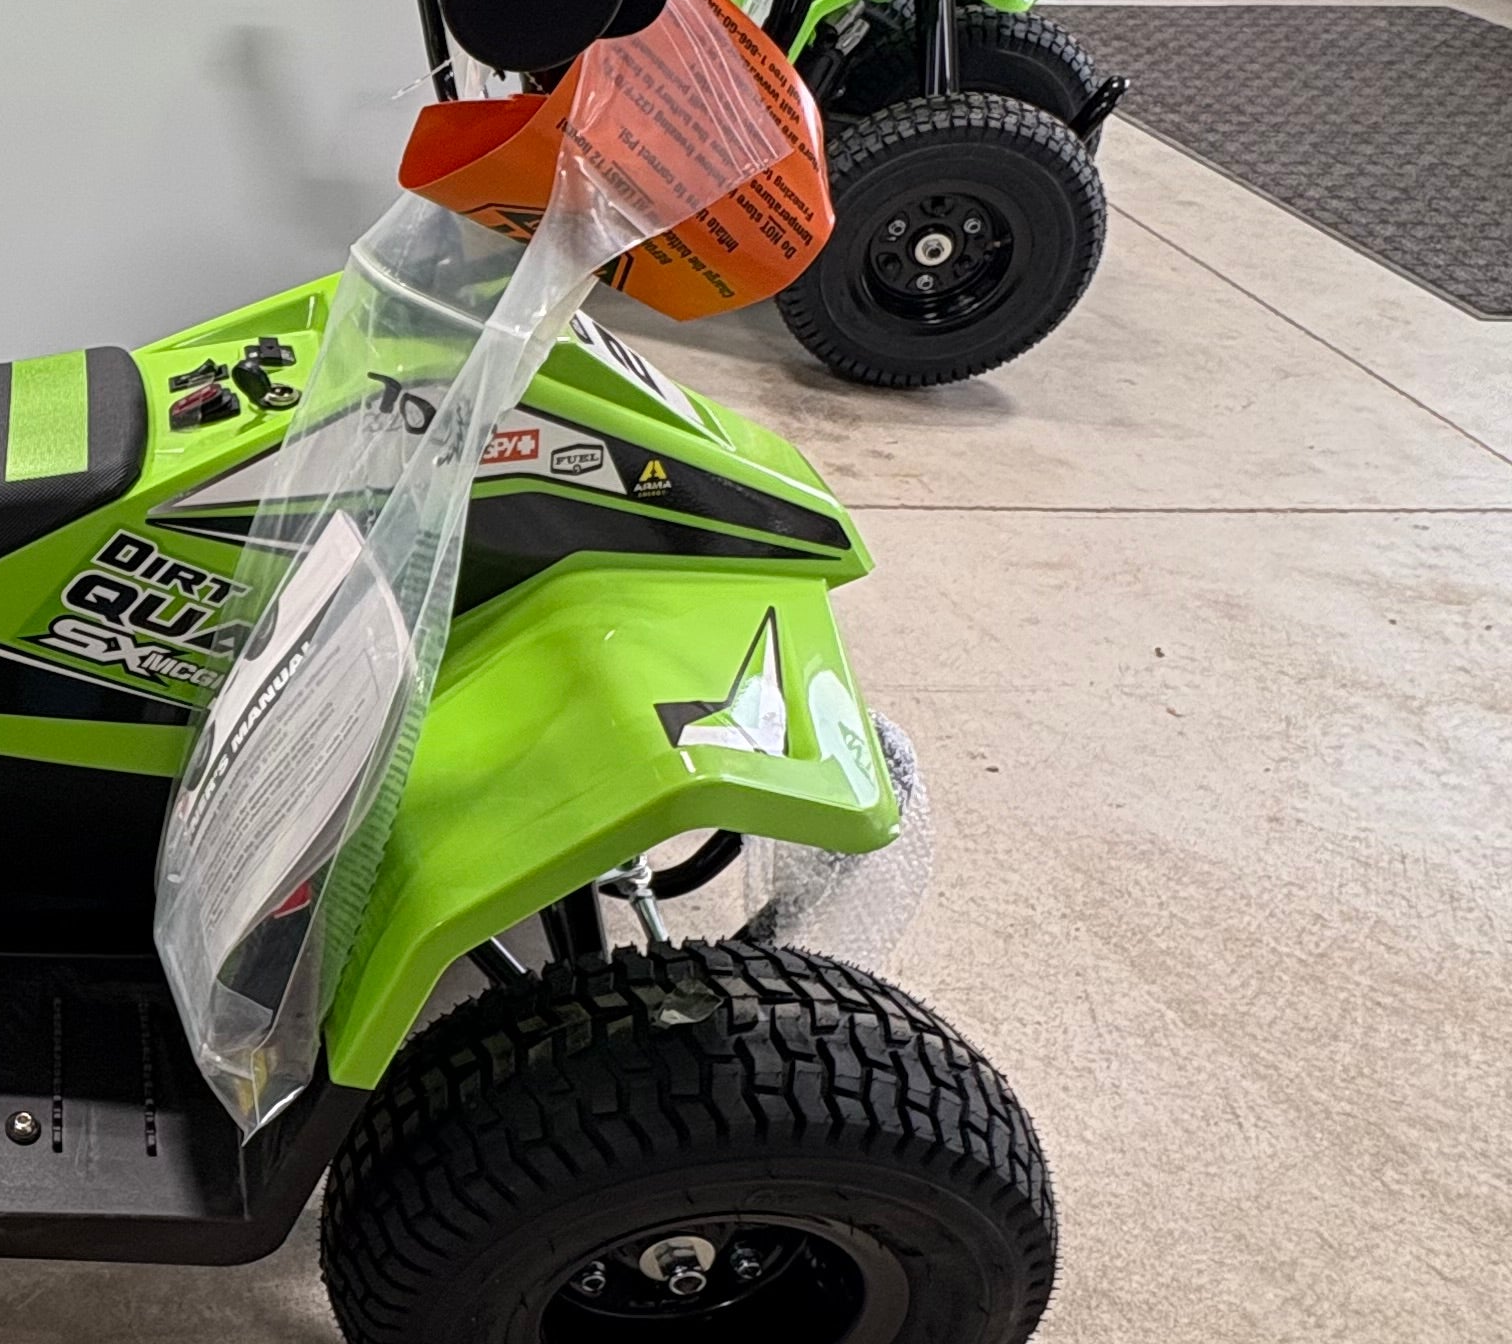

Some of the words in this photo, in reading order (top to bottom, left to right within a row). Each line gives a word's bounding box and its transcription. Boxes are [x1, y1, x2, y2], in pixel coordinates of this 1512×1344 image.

[763, 61, 790, 87] free
[653, 83, 693, 126] battery
[776, 98, 804, 124] visit
[586, 150, 607, 170] 12
[634, 144, 676, 186] correct
[601, 165, 636, 201] LEAST
[771, 175, 815, 222] Freezing
[734, 193, 763, 225] store
[748, 178, 814, 246] temperatures
[658, 229, 691, 260] batter
[705, 216, 738, 253] Inflate
[757, 219, 784, 245] NOT
[686, 255, 706, 274] the
[776, 239, 798, 260] Do
[556, 452, 601, 466] FUEL
[633, 480, 672, 493] ARMA
[92, 530, 251, 607] DIRT
[61, 570, 254, 656] QUA
